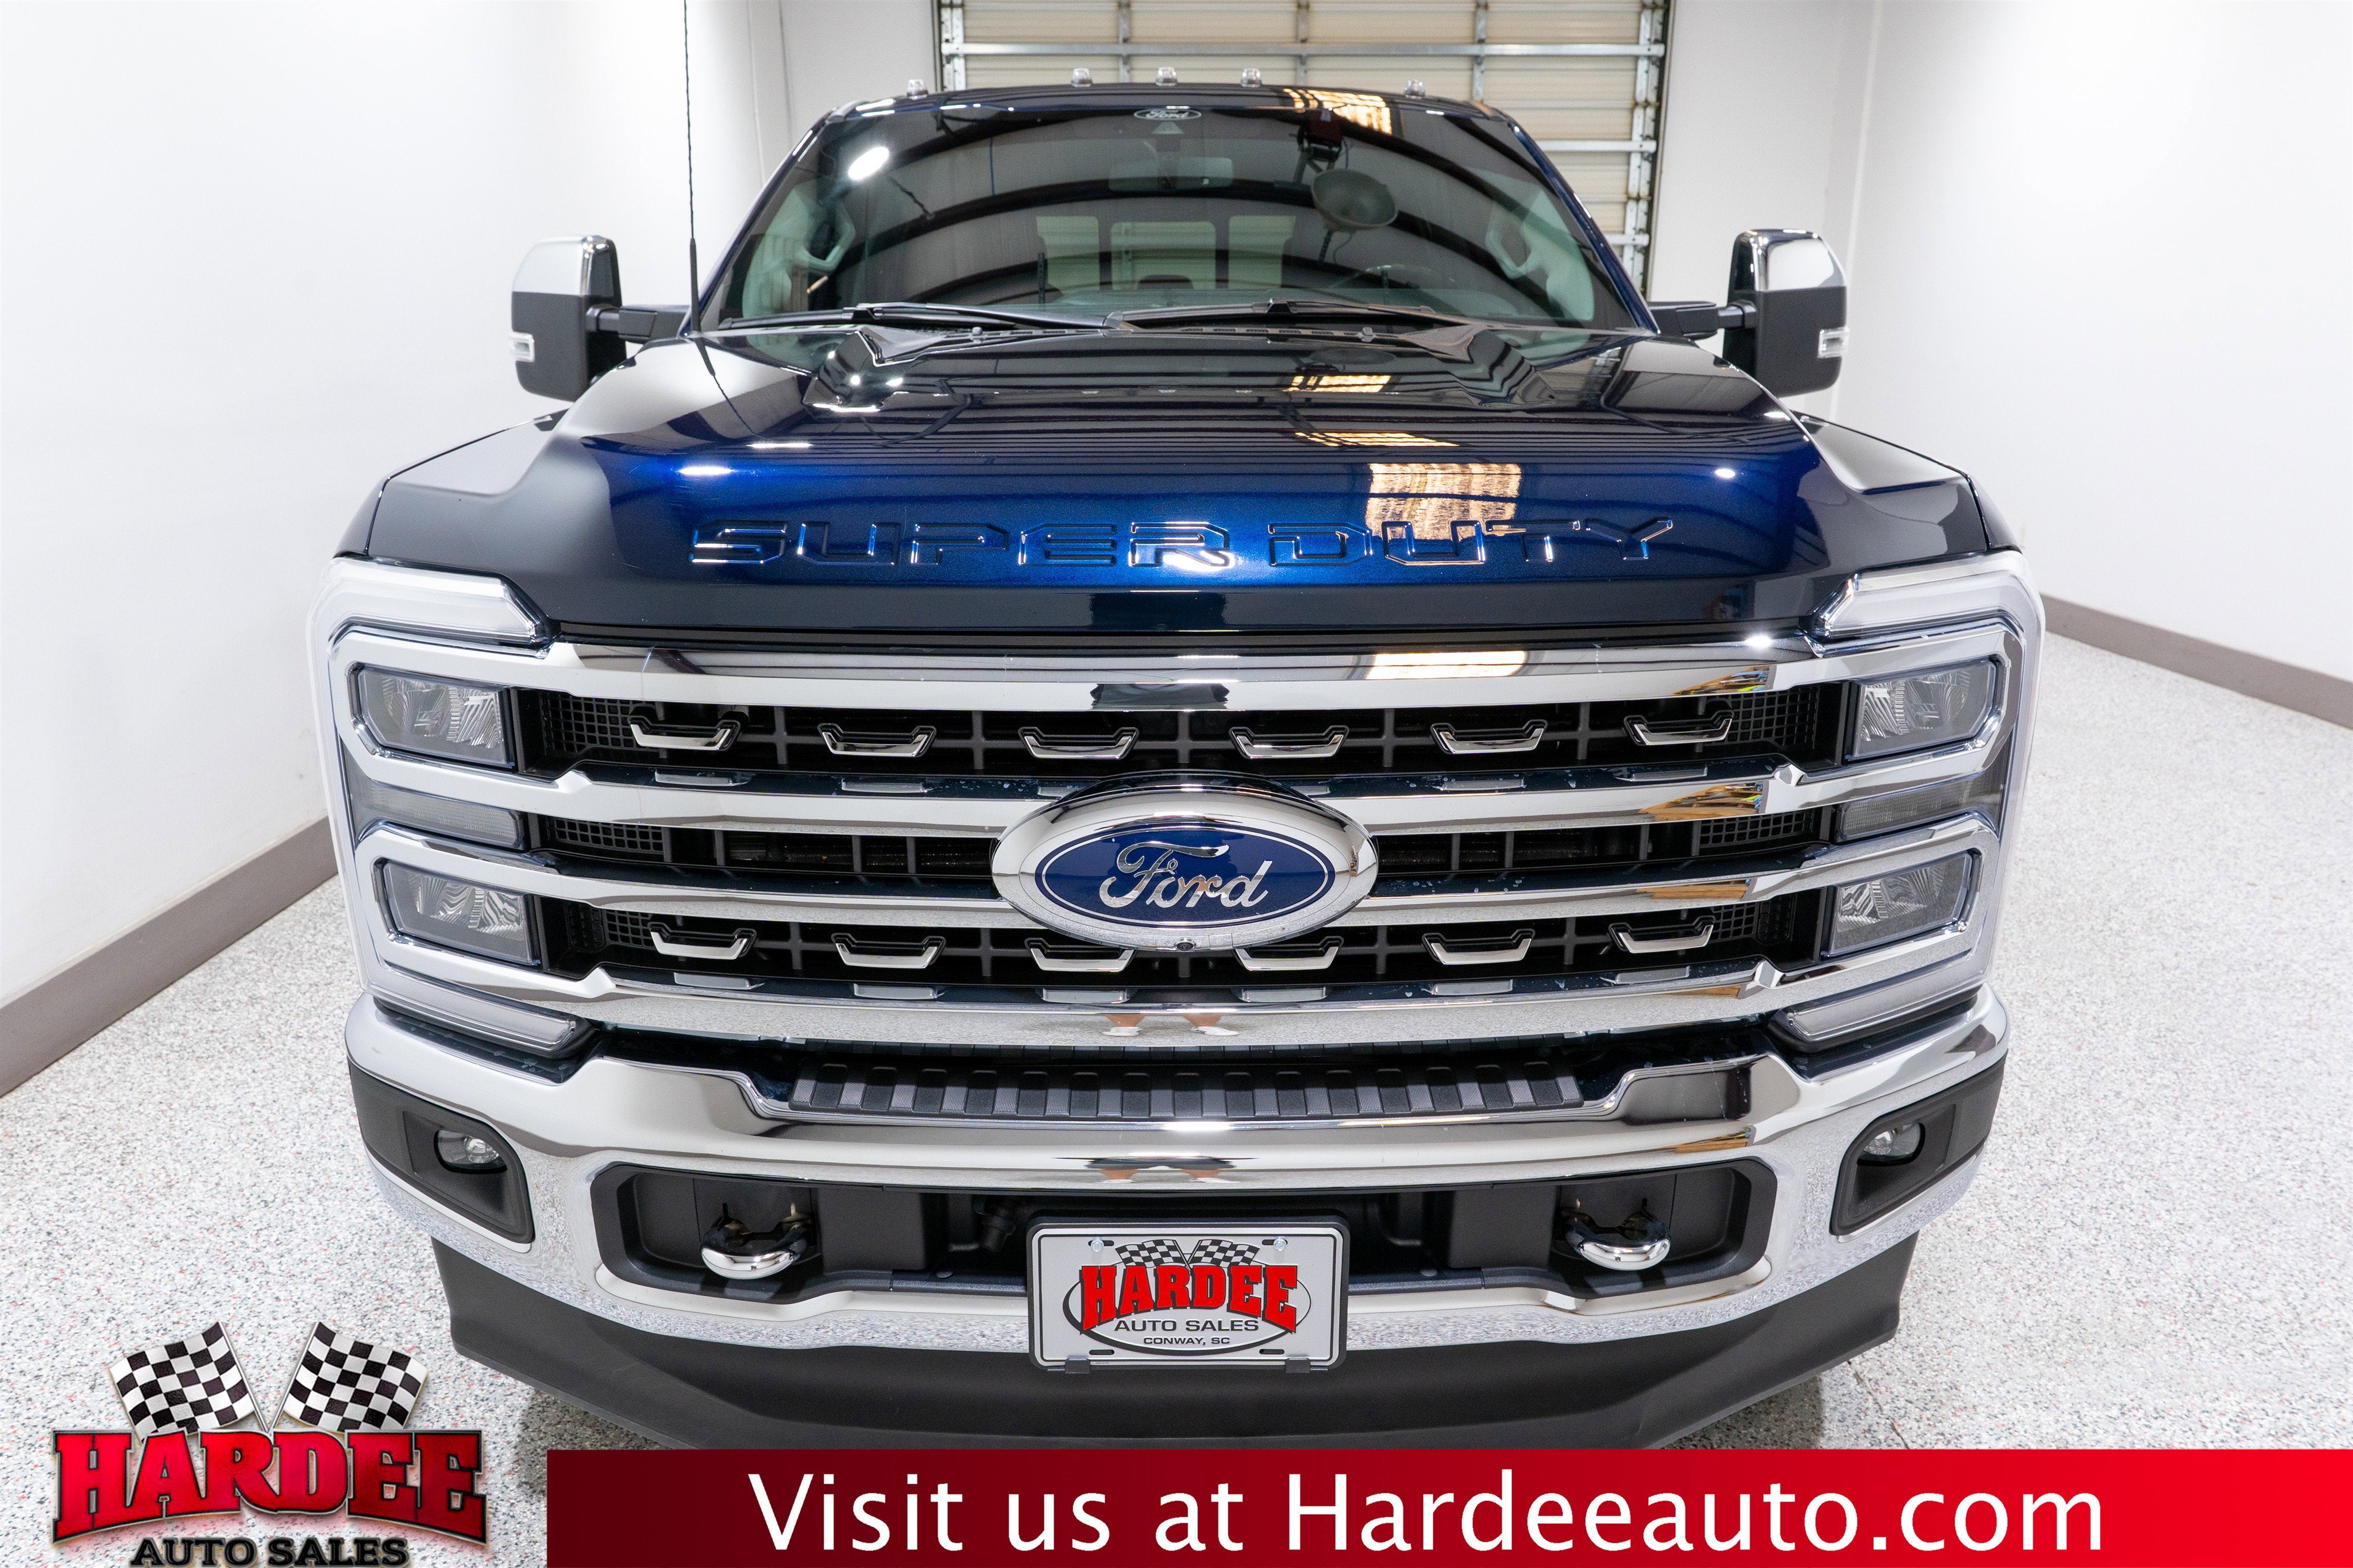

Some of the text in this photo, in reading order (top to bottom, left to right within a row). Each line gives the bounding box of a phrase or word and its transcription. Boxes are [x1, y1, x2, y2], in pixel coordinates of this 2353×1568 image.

[691, 516, 1674, 570] SUPER DUTY
[1099, 841, 1273, 908] Ford
[1079, 1265, 1298, 1334] HARDEE
[1114, 1320, 1259, 1331] AUTO SALES
[1143, 1337, 1206, 1346] CONWAY,
